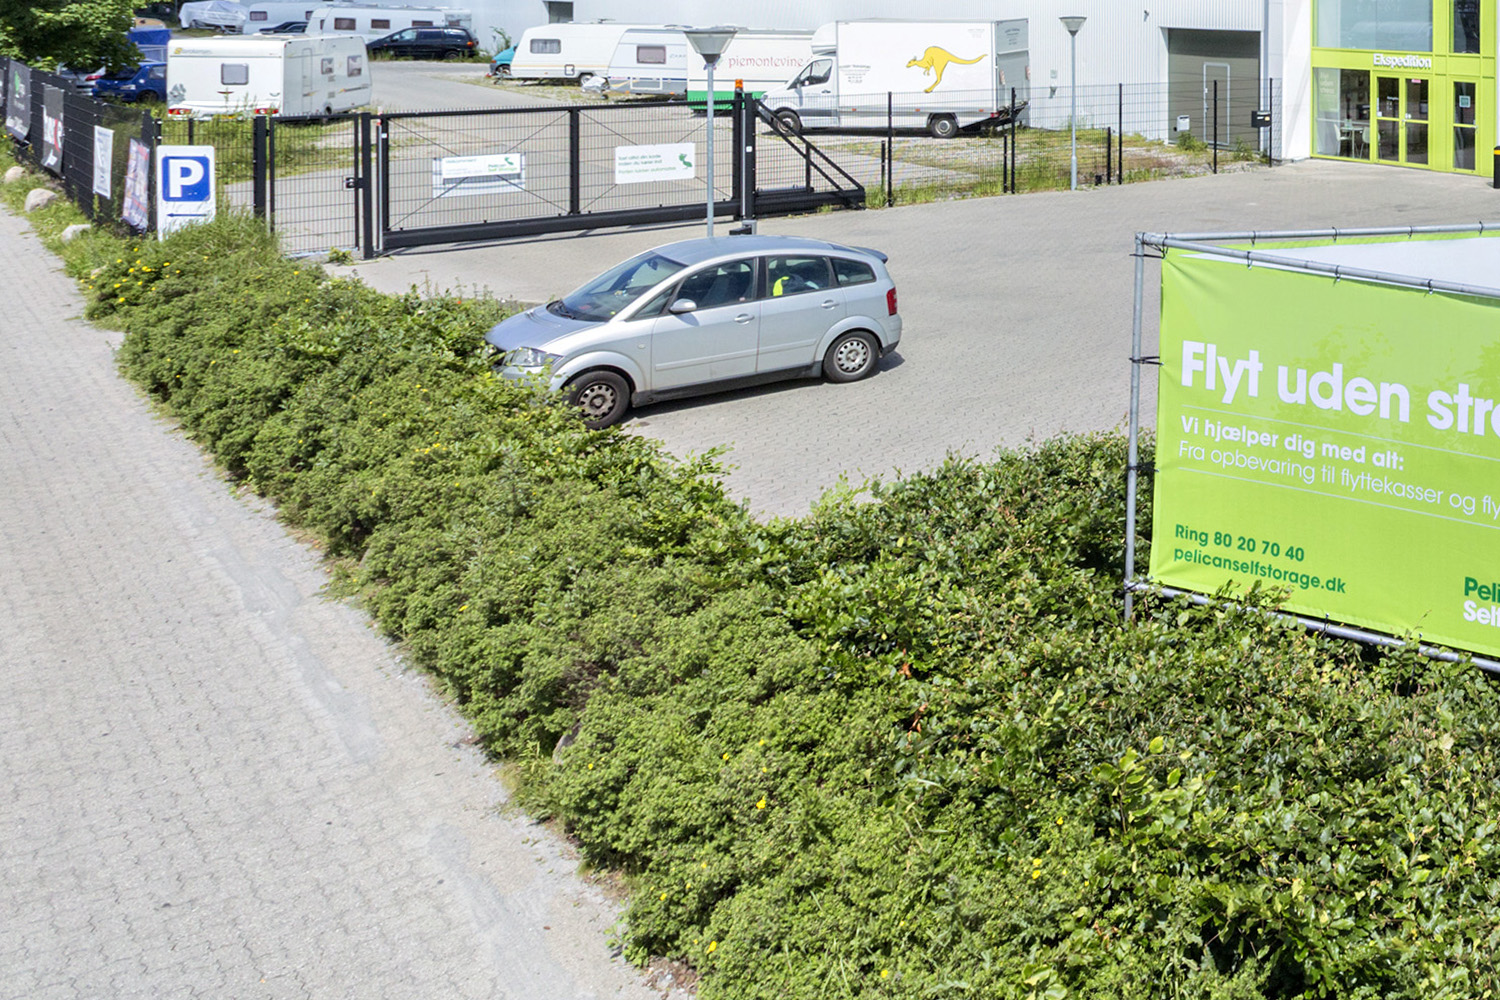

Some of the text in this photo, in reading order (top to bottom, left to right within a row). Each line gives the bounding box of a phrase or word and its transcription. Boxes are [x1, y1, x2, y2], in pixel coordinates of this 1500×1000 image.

[1373, 53, 1432, 68] Ekspedition
[169, 159, 204, 198] P
[1181, 339, 1263, 405] Flyt
[1277, 362, 1410, 423] uden
[1181, 415, 1405, 471] Vi hjælper dig med alt:
[1179, 440, 1205, 461] Fra
[1210, 448, 1316, 485] opbevaring
[1321, 465, 1336, 484] til
[1341, 468, 1443, 504] flyttekasser
[1448, 493, 1476, 516] og
[1175, 524, 1305, 562] Ring 80 20 70 40
[1174, 548, 1347, 594] pelicanselfstorage.dk
